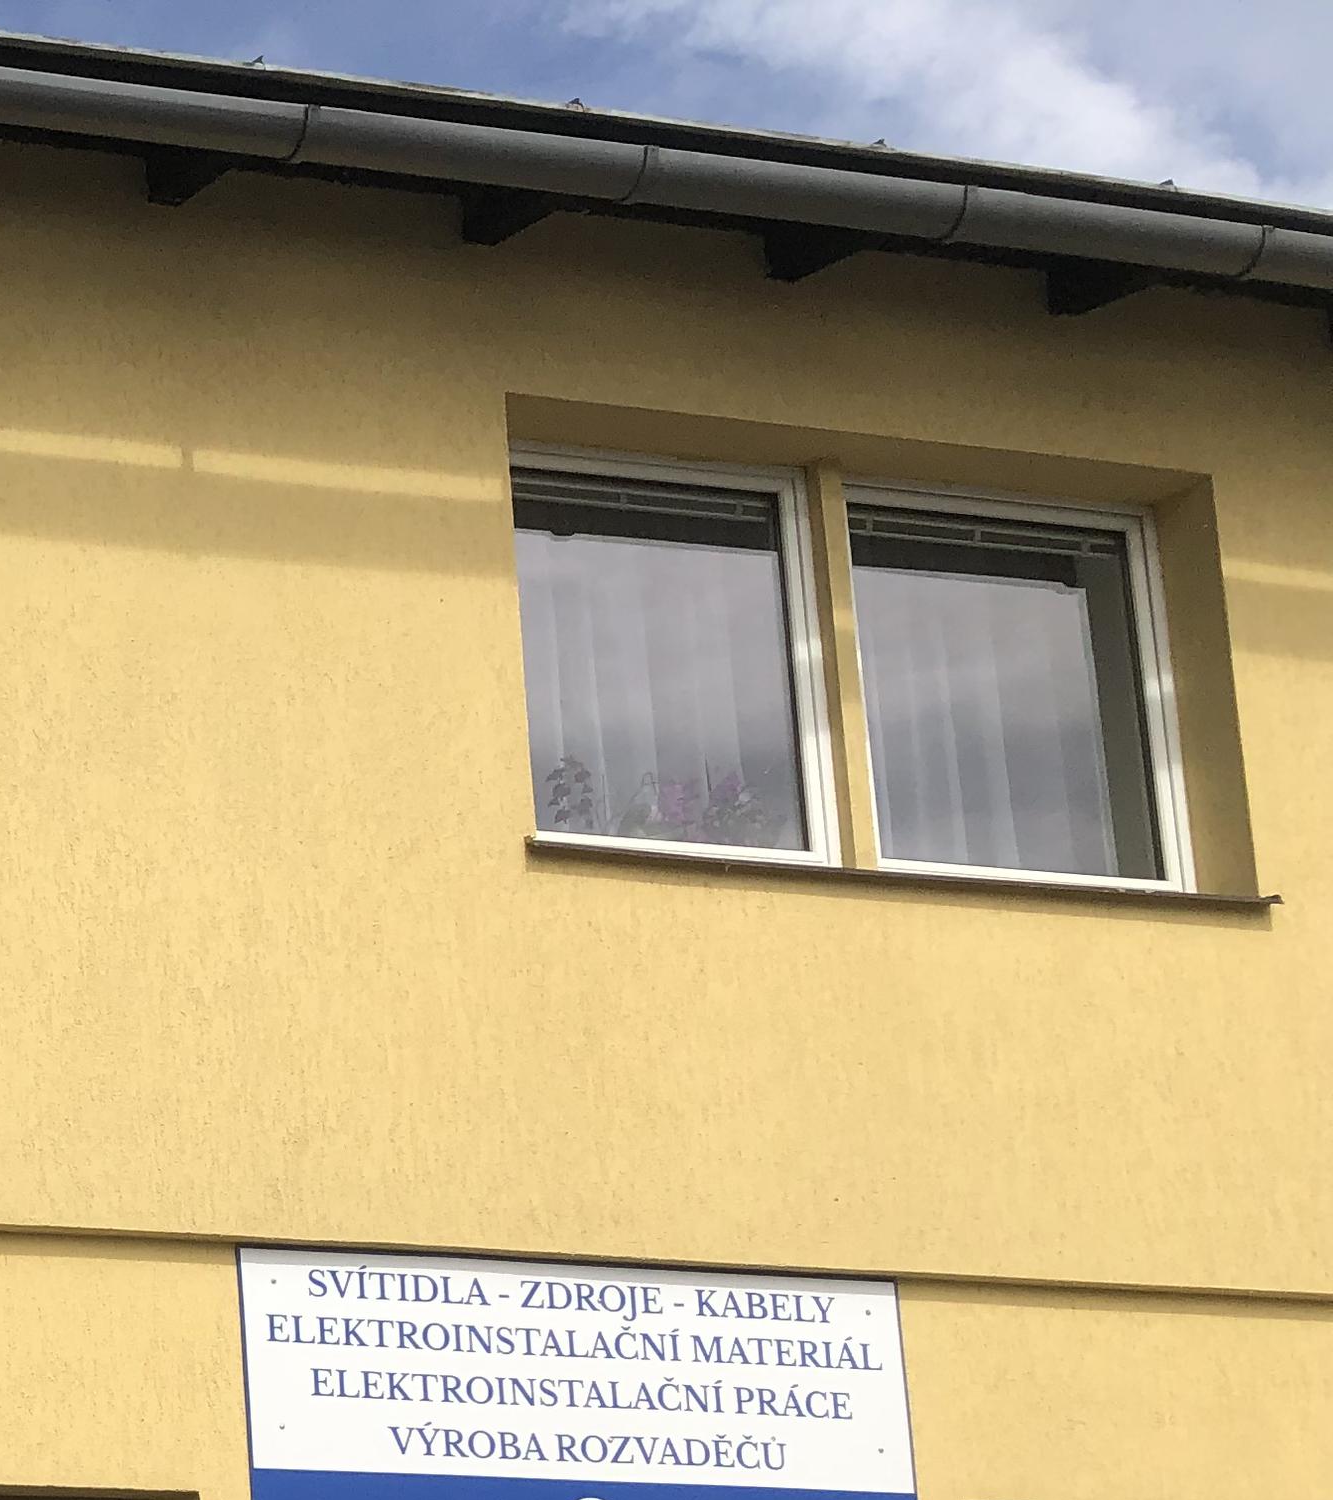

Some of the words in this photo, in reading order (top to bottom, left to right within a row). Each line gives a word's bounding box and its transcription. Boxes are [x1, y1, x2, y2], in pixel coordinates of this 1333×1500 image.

[308, 1265, 490, 1306] SVÍTIDLA
[520, 1280, 663, 1321] ZDROJE
[695, 1289, 834, 1323] KABELY
[266, 1314, 681, 1361] ELEKTROINSTALAČNÍ
[691, 1336, 882, 1370] MATERIÁL
[311, 1368, 724, 1413] ELEKTROINSTALAČNÍ
[734, 1384, 853, 1419] PRÁCE
[388, 1422, 549, 1461] VÝROBA
[555, 1434, 787, 1470] ROZVADĚČŮ
